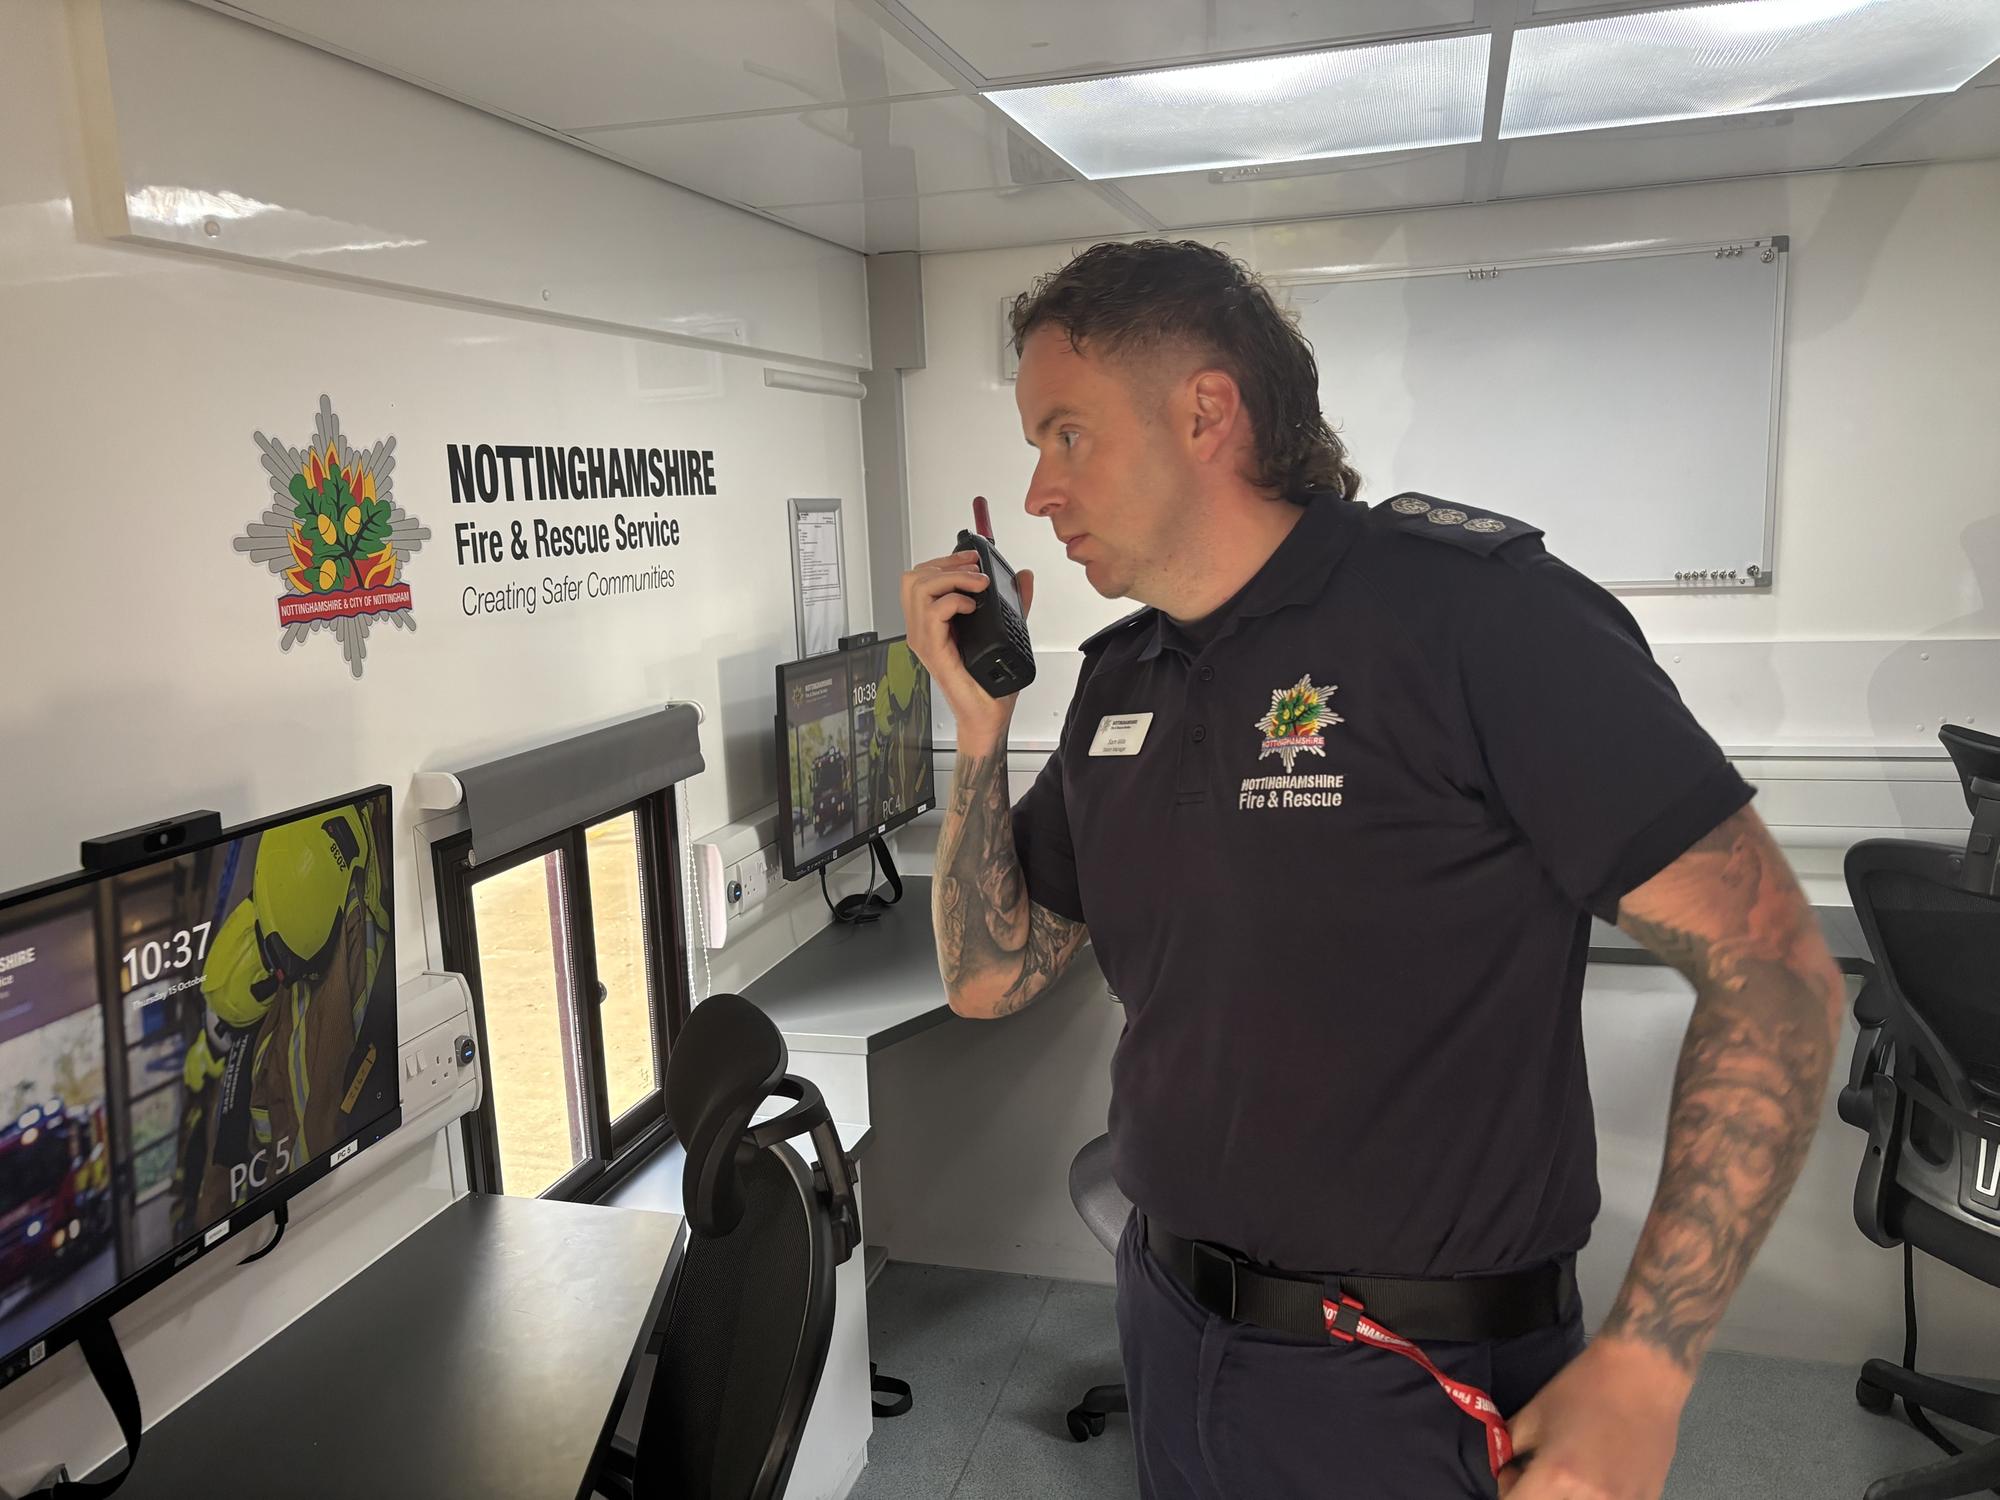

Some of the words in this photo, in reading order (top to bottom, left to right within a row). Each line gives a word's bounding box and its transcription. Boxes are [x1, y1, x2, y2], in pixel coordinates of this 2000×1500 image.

[446, 443, 717, 504] NOTTINGHAMSHIRE
[455, 521, 503, 566] Fire
[510, 520, 530, 561] &
[533, 518, 610, 558] Rescue
[614, 512, 680, 551] Service
[462, 581, 537, 616] Creating
[542, 575, 583, 605] Safer
[587, 564, 675, 598] Communities
[281, 599, 343, 617] NOTTINGHAMSHIRE
[343, 600, 349, 609] &
[349, 596, 364, 609] CITY
[364, 595, 373, 607] OF
[372, 591, 410, 606] NOTTINGHAM
[852, 682, 877, 705] 10:38
[1241, 774, 1344, 792] NOTTINGHAMSHIRE
[882, 797, 895, 819] PC
[1239, 790, 1265, 810] Fire
[1267, 790, 1279, 808] &
[1283, 790, 1342, 808] Rescue
[330, 843, 346, 872] 2038
[122, 920, 213, 987] 10:37
[168, 986, 178, 996] 15
[177, 974, 208, 991] October
[337, 1148, 347, 1161] PC
[230, 1148, 268, 1204] PC
[275, 1135, 290, 1176] 5
